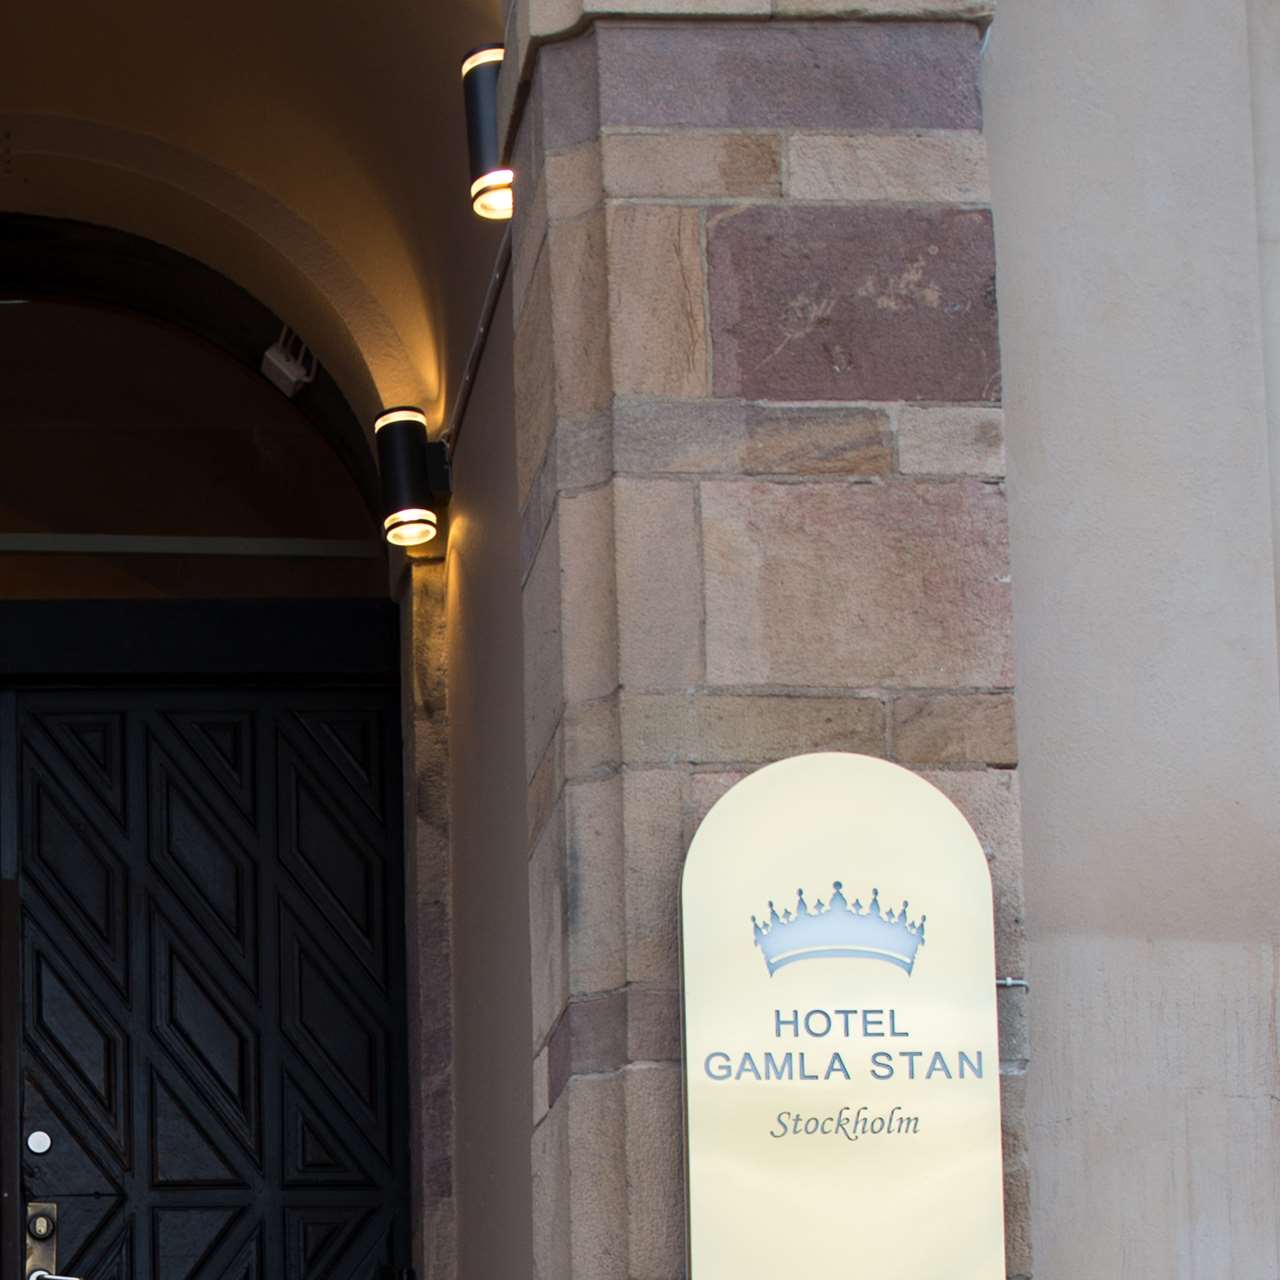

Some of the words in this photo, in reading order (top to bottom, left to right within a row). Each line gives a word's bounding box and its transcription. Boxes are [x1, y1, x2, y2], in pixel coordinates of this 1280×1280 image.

[774, 1009, 910, 1038] HOTEL
[704, 1051, 851, 1081] GAMLA
[870, 1050, 984, 1080] STAN
[769, 1106, 920, 1142] Stockholm
